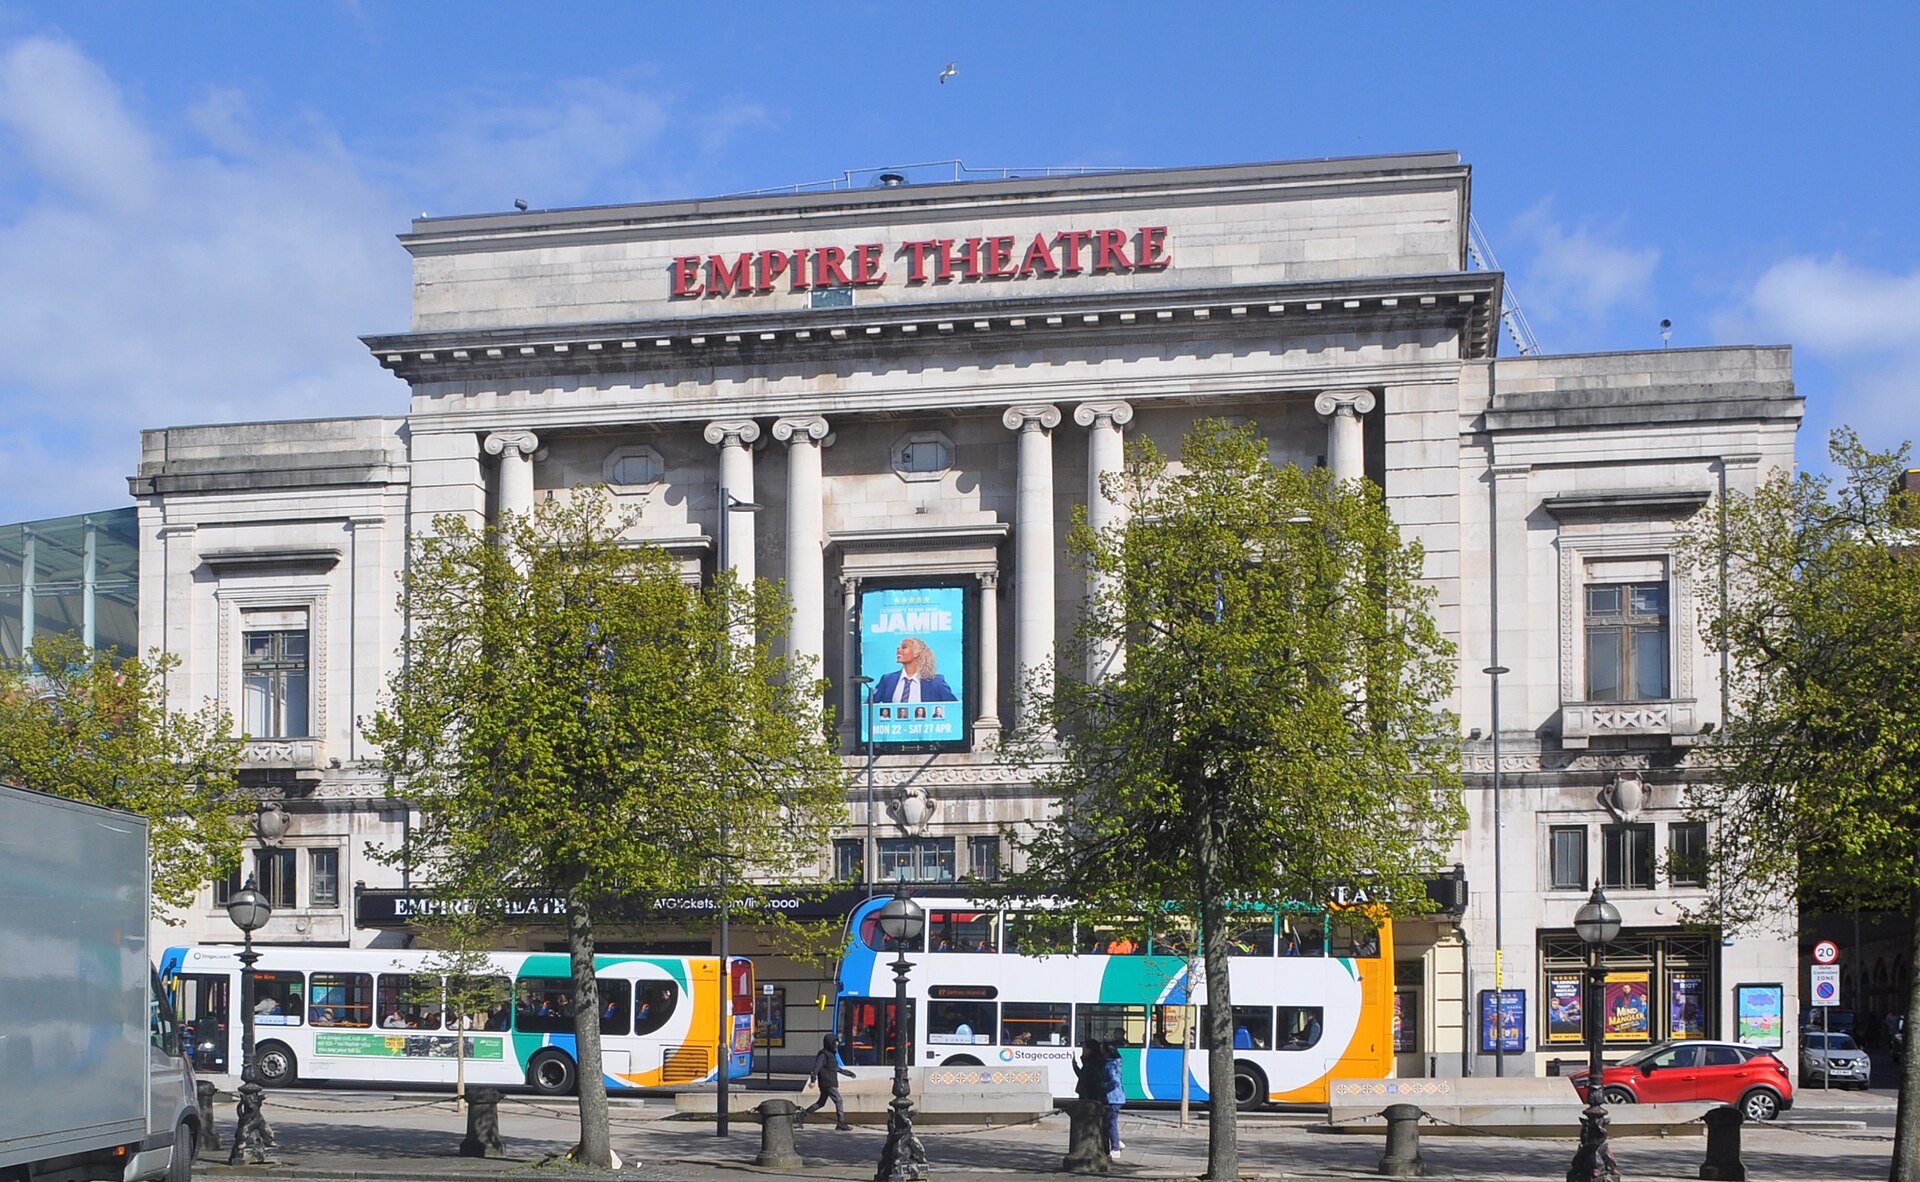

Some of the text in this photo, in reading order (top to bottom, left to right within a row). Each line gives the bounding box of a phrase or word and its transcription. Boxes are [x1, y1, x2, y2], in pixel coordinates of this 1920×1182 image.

[673, 226, 1172, 296] EMPIRE THEATRE
[871, 611, 952, 633] JAMIE
[872, 725, 890, 735] MON
[892, 724, 902, 735] 22
[909, 723, 923, 734] SAT
[924, 723, 934, 734] 27
[935, 723, 952, 734] APR
[202, 952, 231, 960] Stagecoach
[1817, 948, 1834, 957] 20
[1015, 1050, 1072, 1061] Stagecoach
